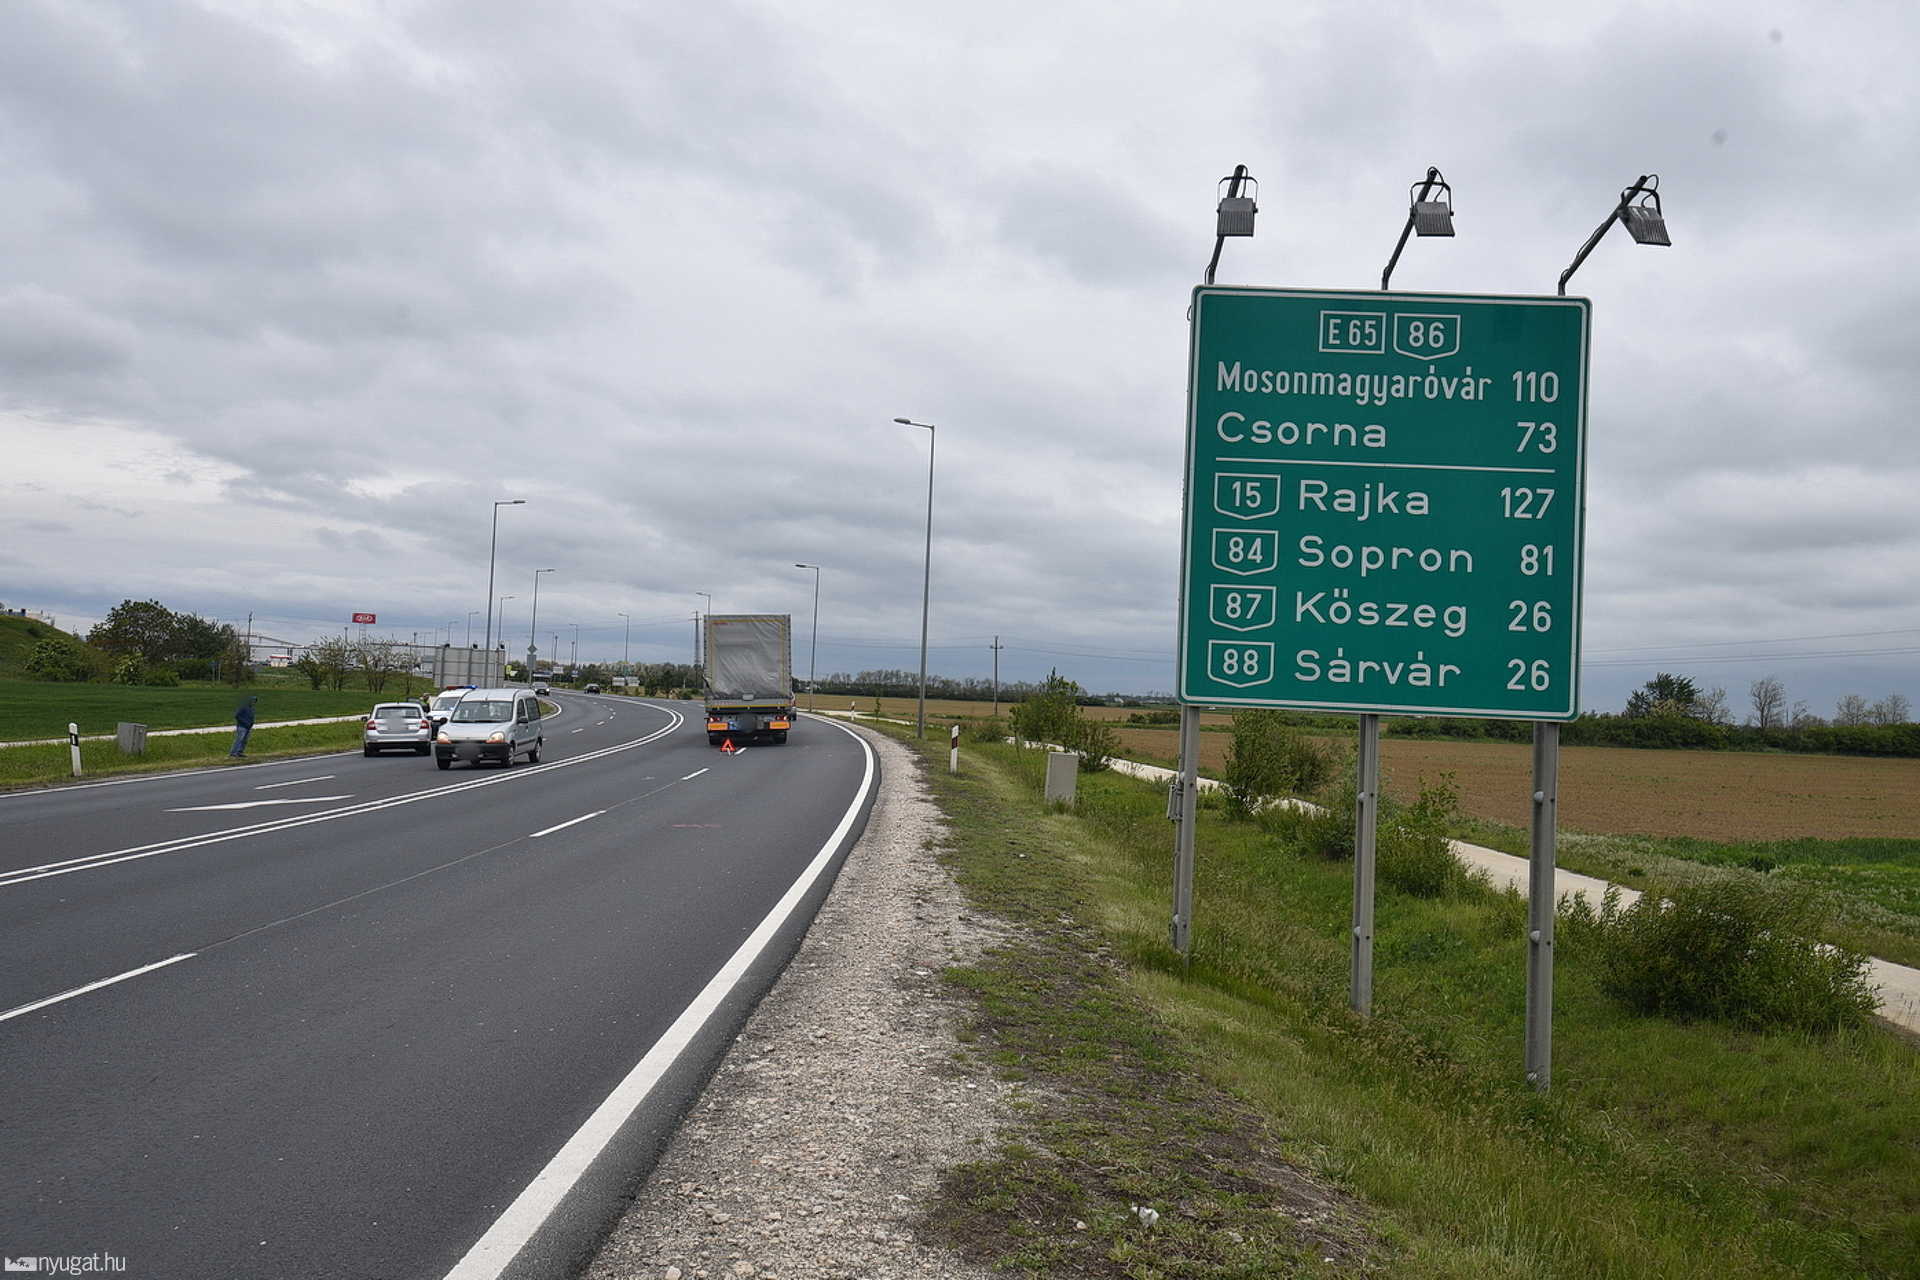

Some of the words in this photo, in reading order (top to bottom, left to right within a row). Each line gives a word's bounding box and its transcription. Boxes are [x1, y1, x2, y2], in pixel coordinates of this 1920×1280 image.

[1329, 319, 1341, 345] E
[1348, 319, 1377, 346] 65
[1409, 321, 1445, 348] 86
[1217, 361, 1492, 406] Mosonmagyaróvár
[1512, 371, 1559, 402] 110
[1217, 412, 1386, 447] Csorna
[1517, 422, 1557, 454] 73
[1231, 481, 1262, 508] 15
[1299, 479, 1429, 521] Rajka
[1501, 487, 1555, 519] 127
[1228, 537, 1263, 564] 84
[1298, 535, 1473, 577] Sopron
[1520, 544, 1553, 576] 81
[1226, 593, 1262, 619] 87
[1508, 600, 1552, 632] 26
[1223, 649, 1259, 675] 88
[1295, 647, 1461, 687] Sárvár
[1507, 659, 1550, 691] 26
